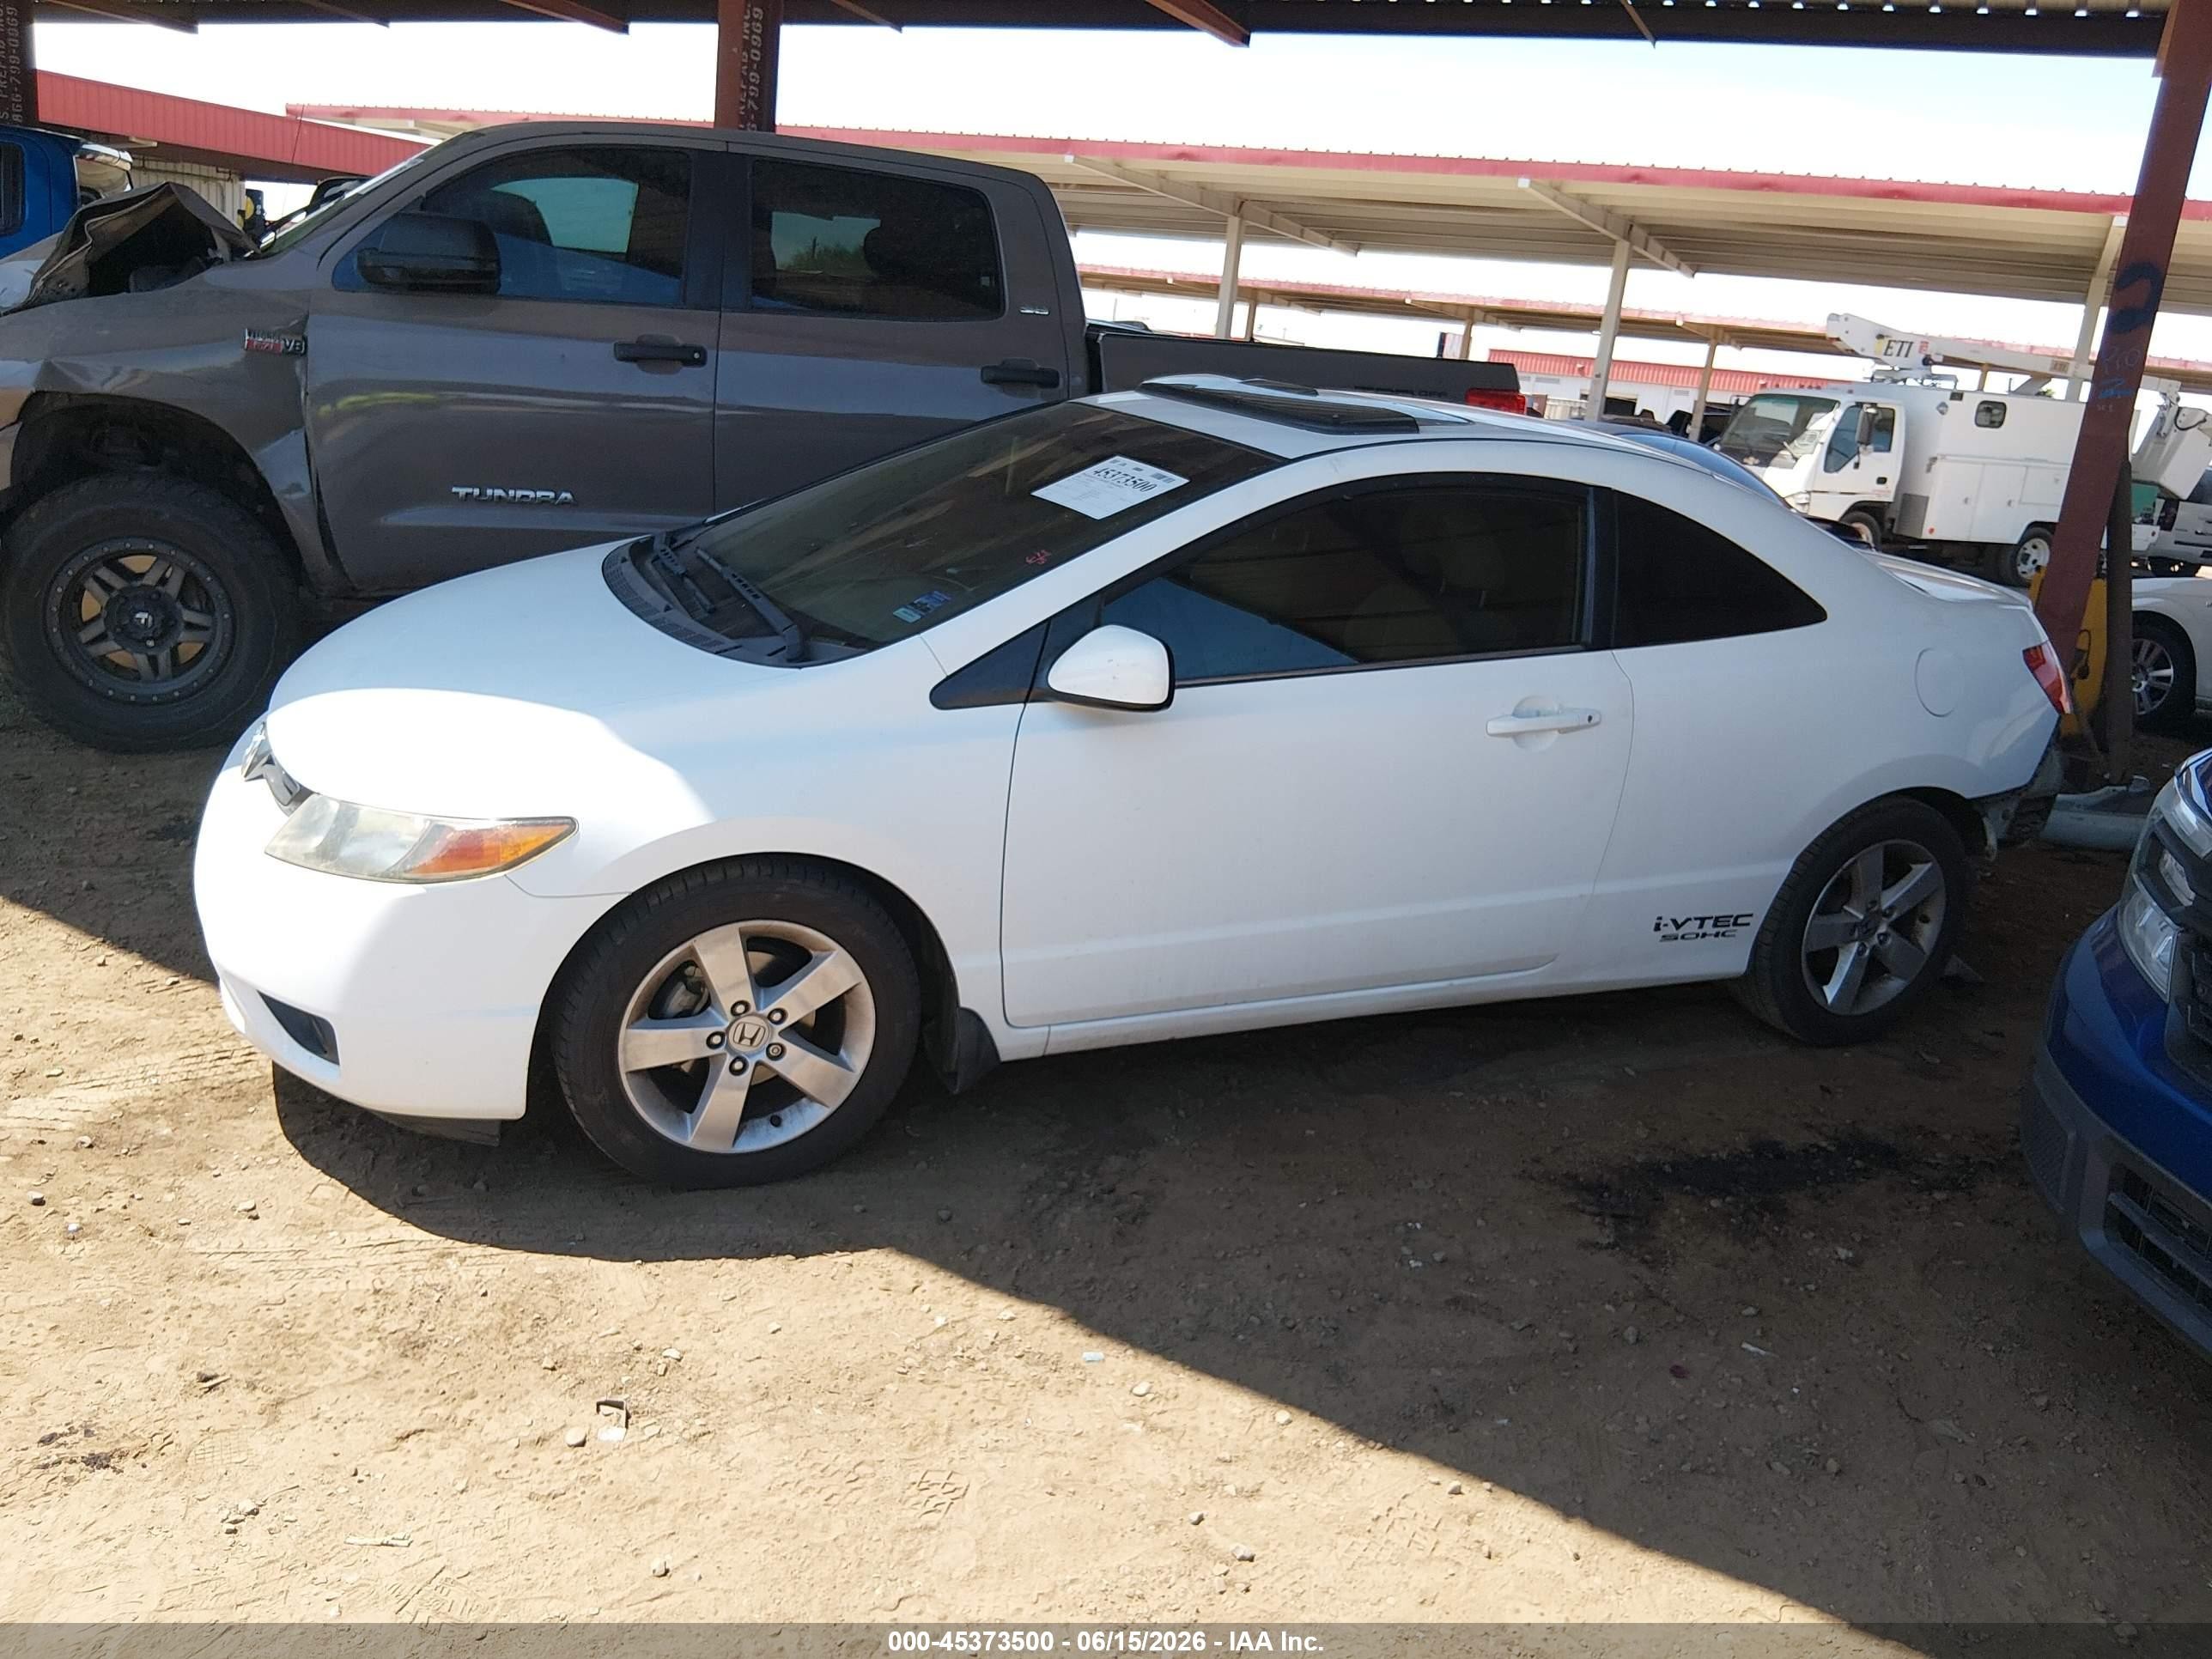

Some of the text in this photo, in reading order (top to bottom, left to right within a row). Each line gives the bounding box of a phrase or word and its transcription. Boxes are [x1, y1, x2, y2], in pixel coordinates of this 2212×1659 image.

[1884, 339, 1913, 358] ETI
[1092, 467, 1158, 492] 45373500
[452, 486, 575, 505] TUNDRA
[1653, 913, 1753, 933] i-VTEC
[1660, 928, 1738, 942] SOHC
